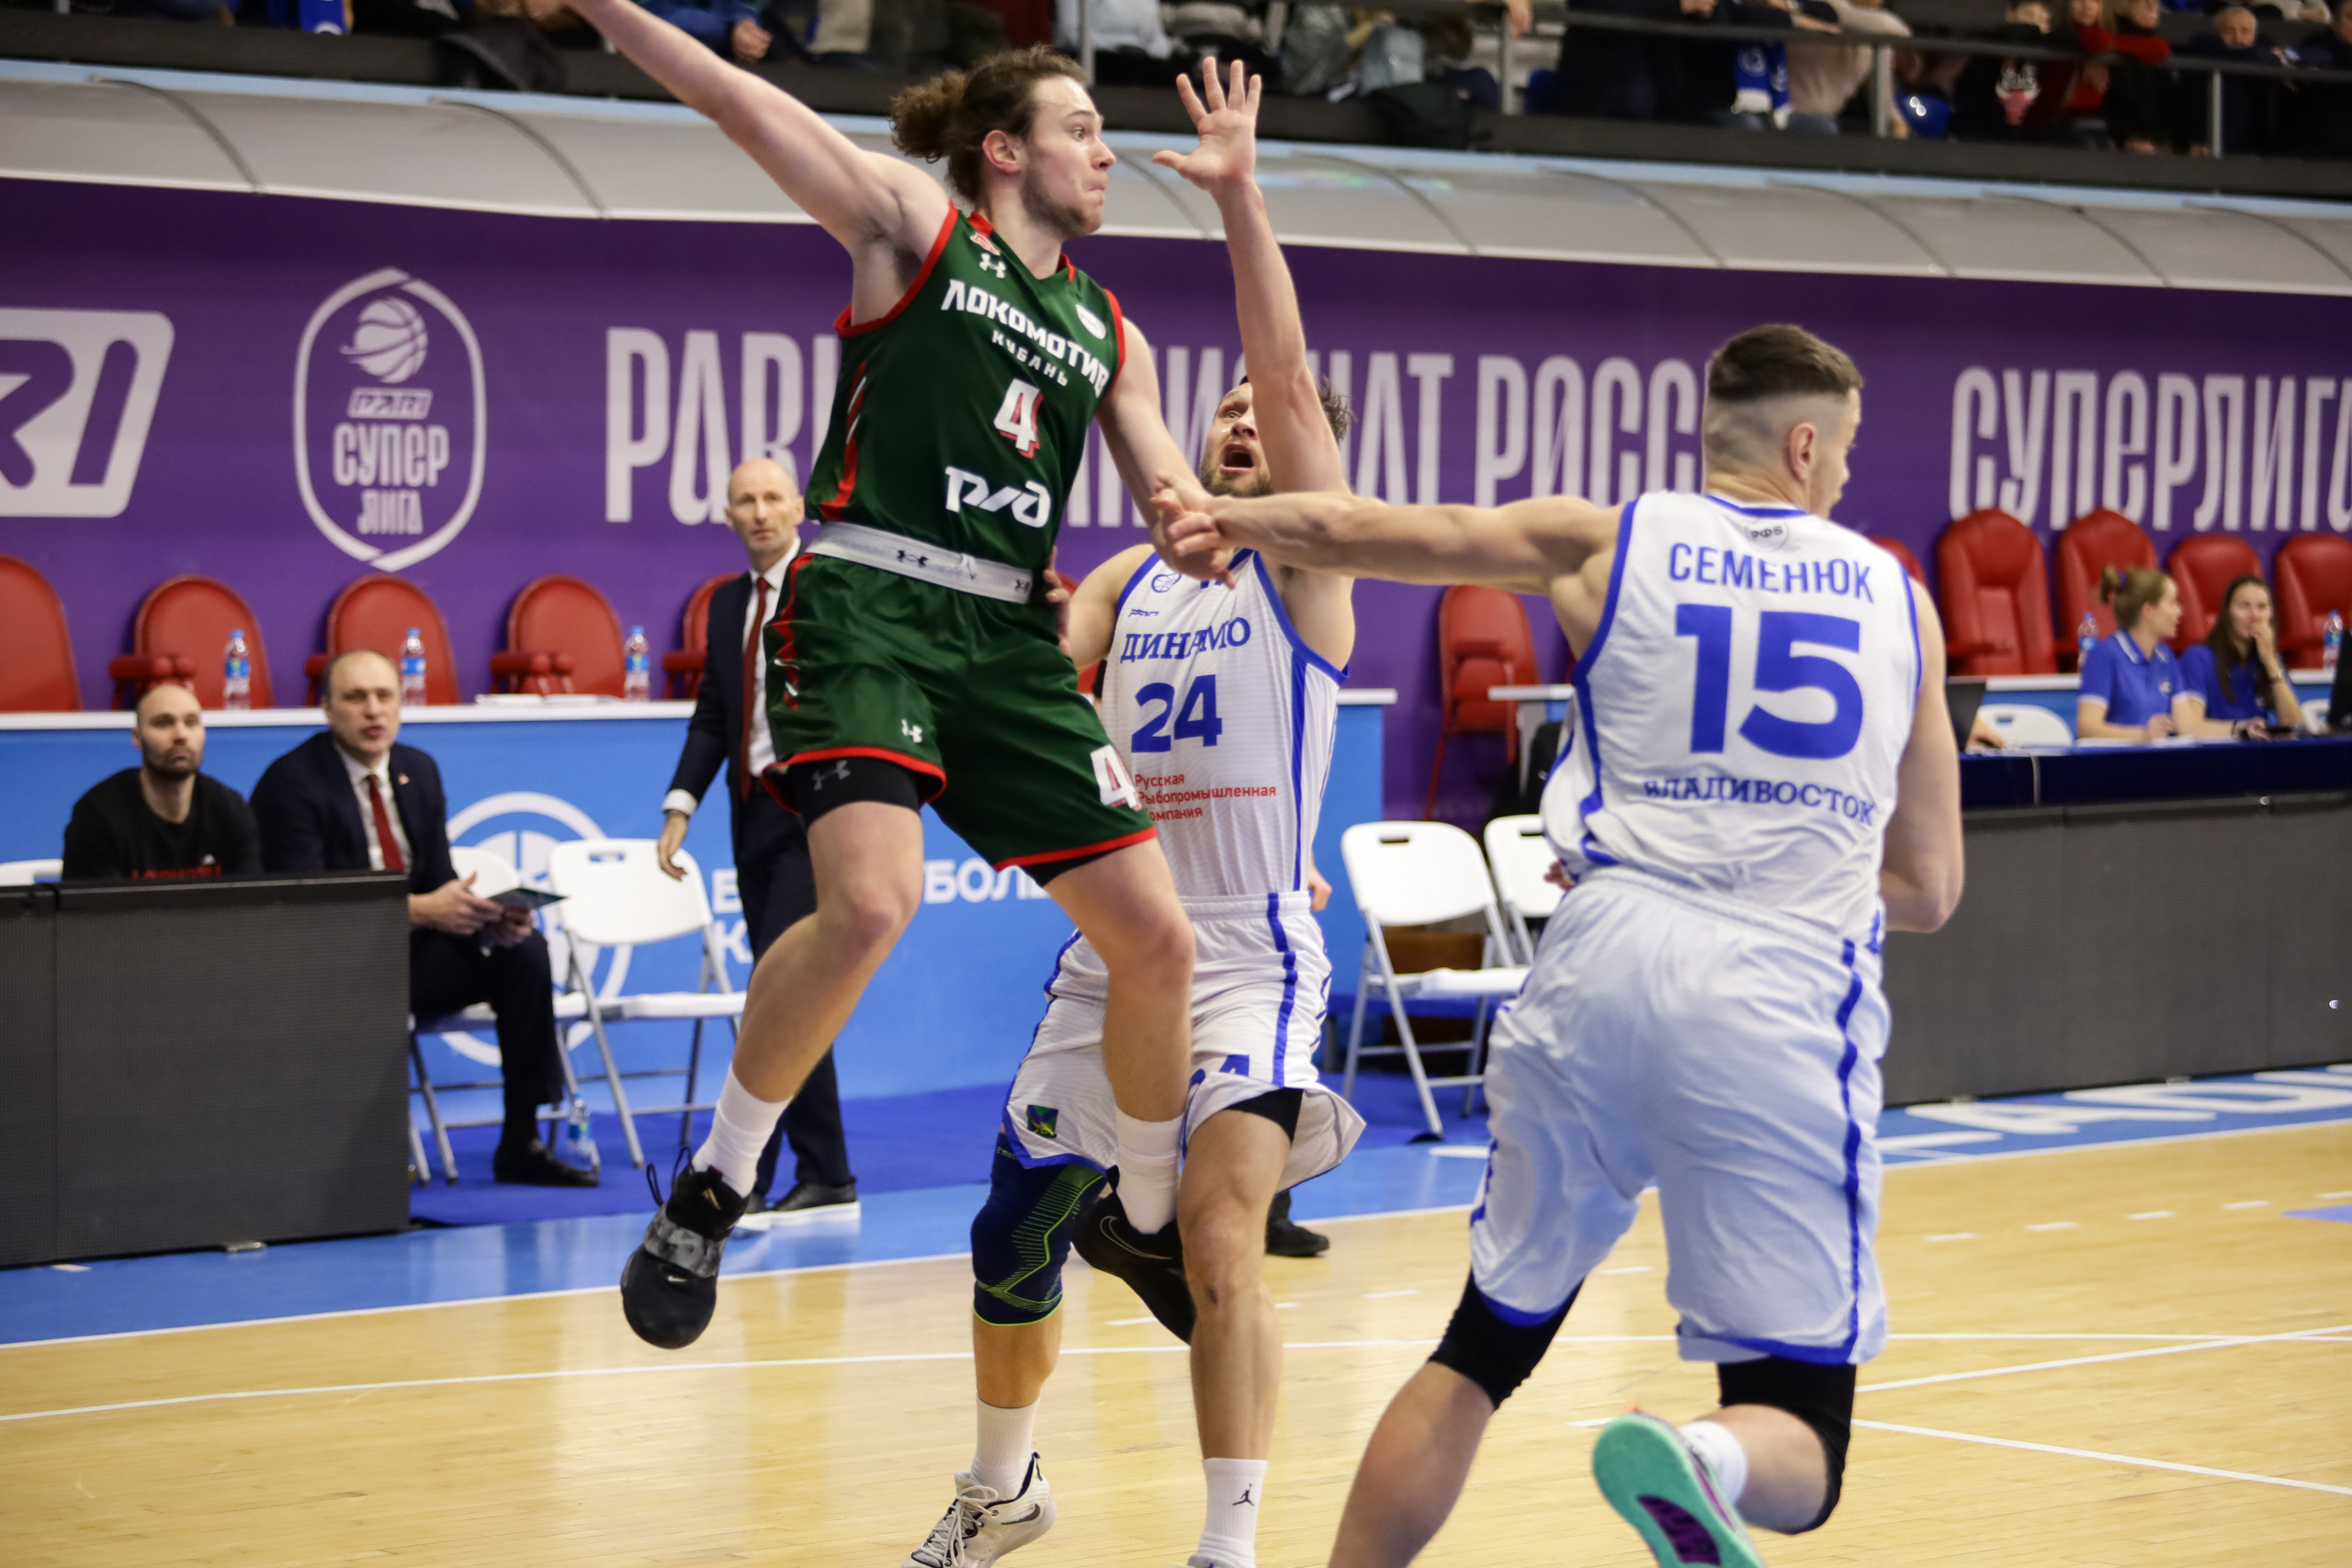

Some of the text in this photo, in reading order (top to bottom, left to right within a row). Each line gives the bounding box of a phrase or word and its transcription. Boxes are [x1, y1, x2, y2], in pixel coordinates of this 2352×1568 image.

[941, 278, 1110, 396] ЛОКОМОТИВ
[992, 330, 1069, 387] КУБАНЬ
[993, 378, 1045, 458] 4
[333, 422, 450, 488] СУПЕР
[1668, 542, 1875, 604] СЕМЕНЮК
[1120, 616, 1251, 664] ДИНАМО
[1131, 673, 1223, 753] 24
[1675, 603, 1863, 761] 15
[1090, 743, 1142, 811] 4
[1135, 773, 1185, 791] Русская
[1147, 807, 1204, 822] омпания
